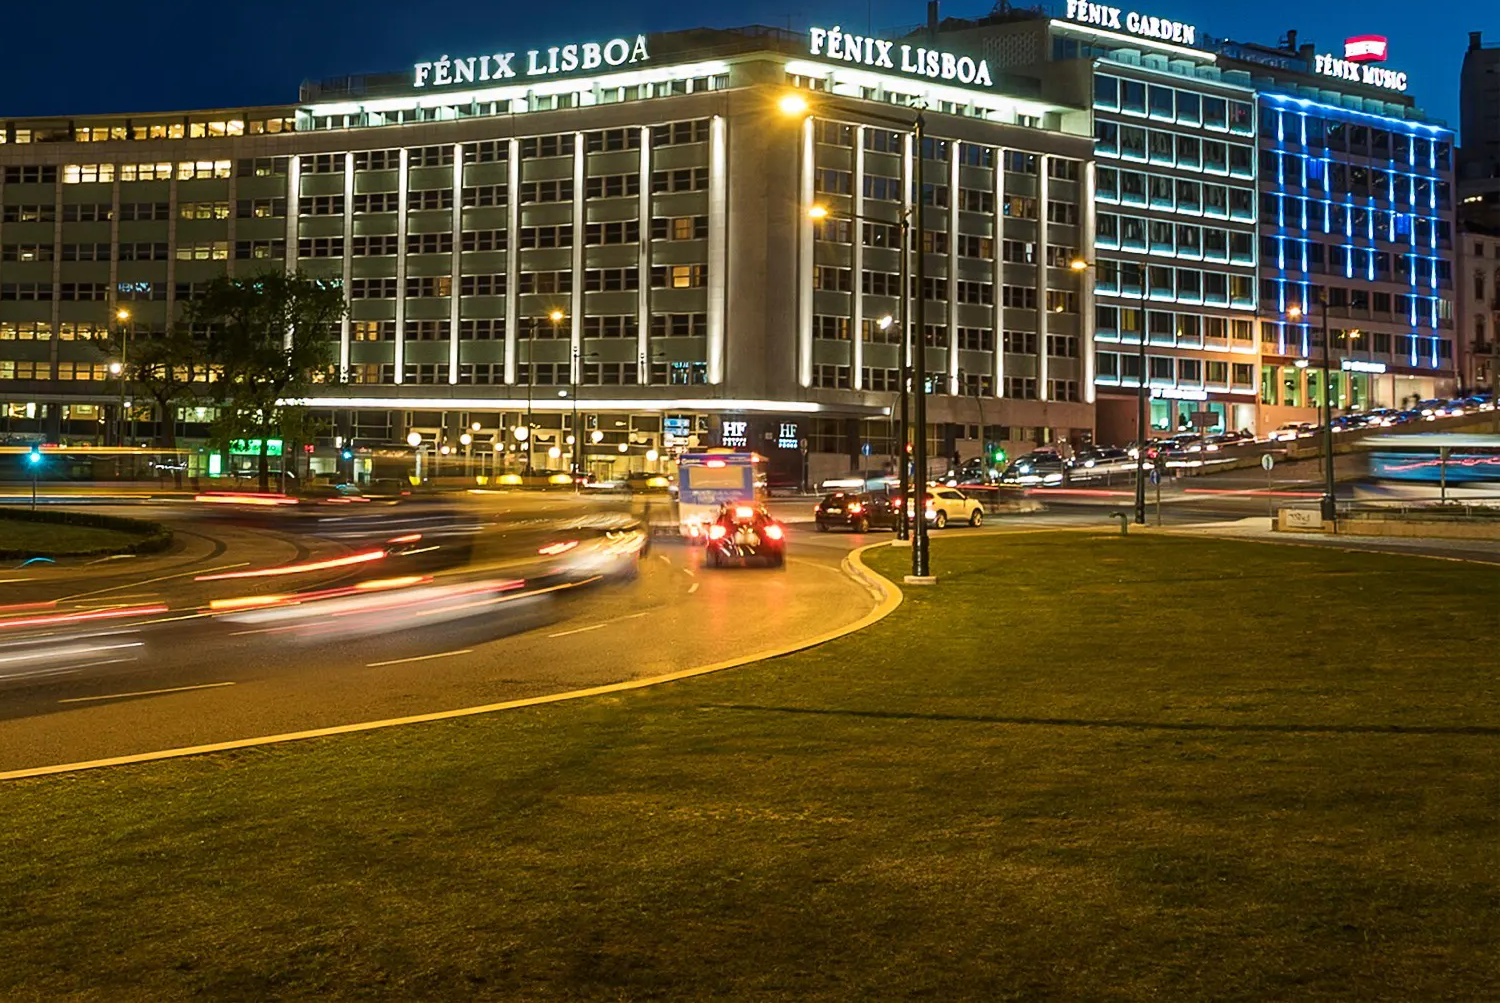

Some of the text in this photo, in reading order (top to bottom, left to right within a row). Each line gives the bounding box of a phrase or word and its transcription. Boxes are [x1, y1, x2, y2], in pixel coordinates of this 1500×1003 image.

[1126, 11, 1196, 45] GARDEN
[413, 34, 650, 87] FÉNIX LISBOA
[809, 25, 993, 86] FÉNIX LISBOA
[1315, 53, 1407, 91] FÉNIX MUSIC
[722, 421, 747, 437] HF
[779, 423, 798, 438] HF
